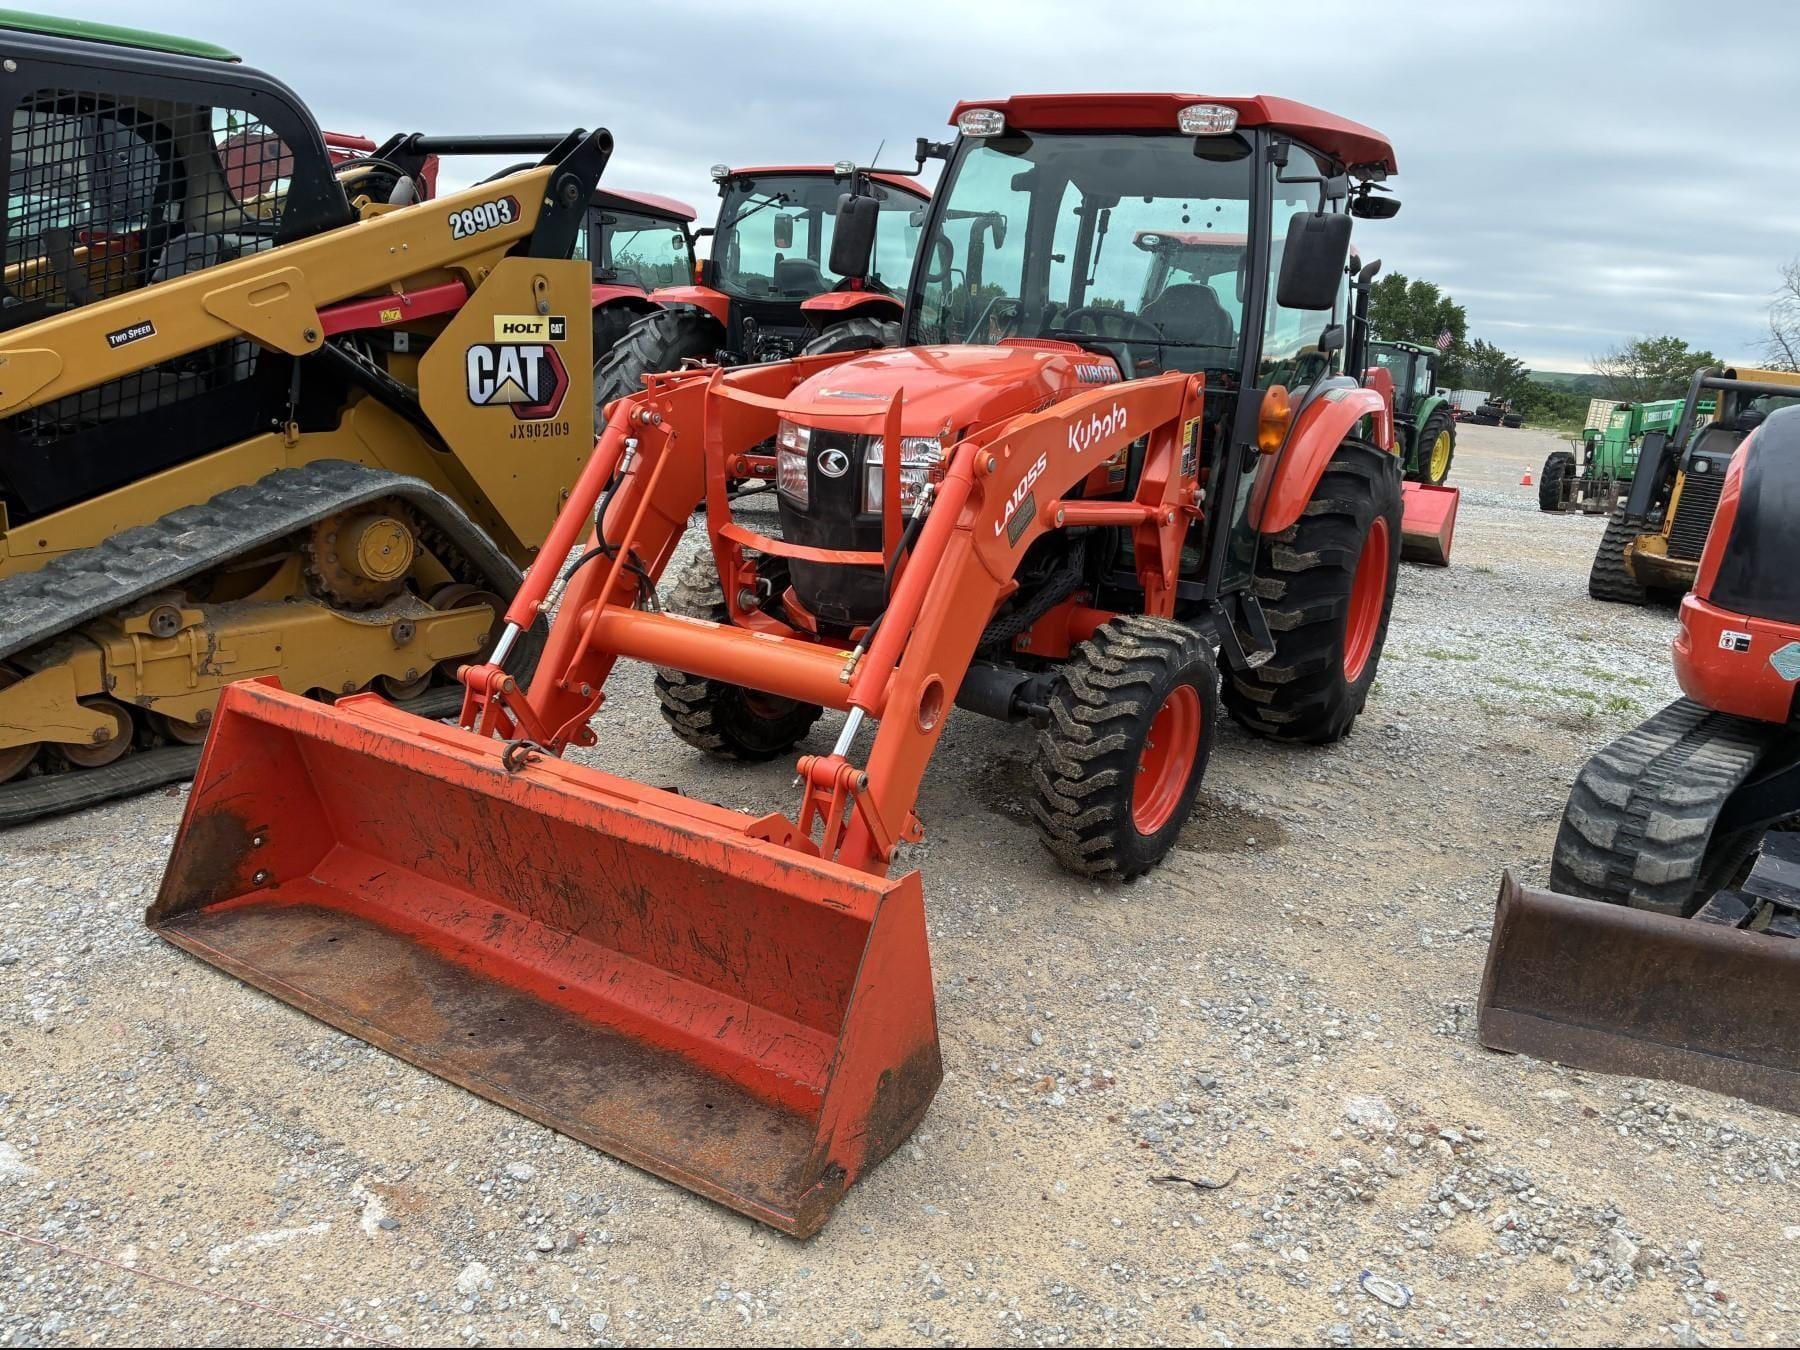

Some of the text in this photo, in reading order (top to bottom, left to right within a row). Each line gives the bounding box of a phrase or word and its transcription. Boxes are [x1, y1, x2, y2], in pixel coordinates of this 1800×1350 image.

[449, 199, 512, 240] 289D3
[503, 323, 564, 334] HOLT CAT
[467, 345, 544, 404] CAT
[1073, 364, 1119, 384] KUBOTA
[510, 422, 570, 439] JX902109
[1068, 402, 1127, 453] Kubota
[995, 451, 1047, 537] LA1055
